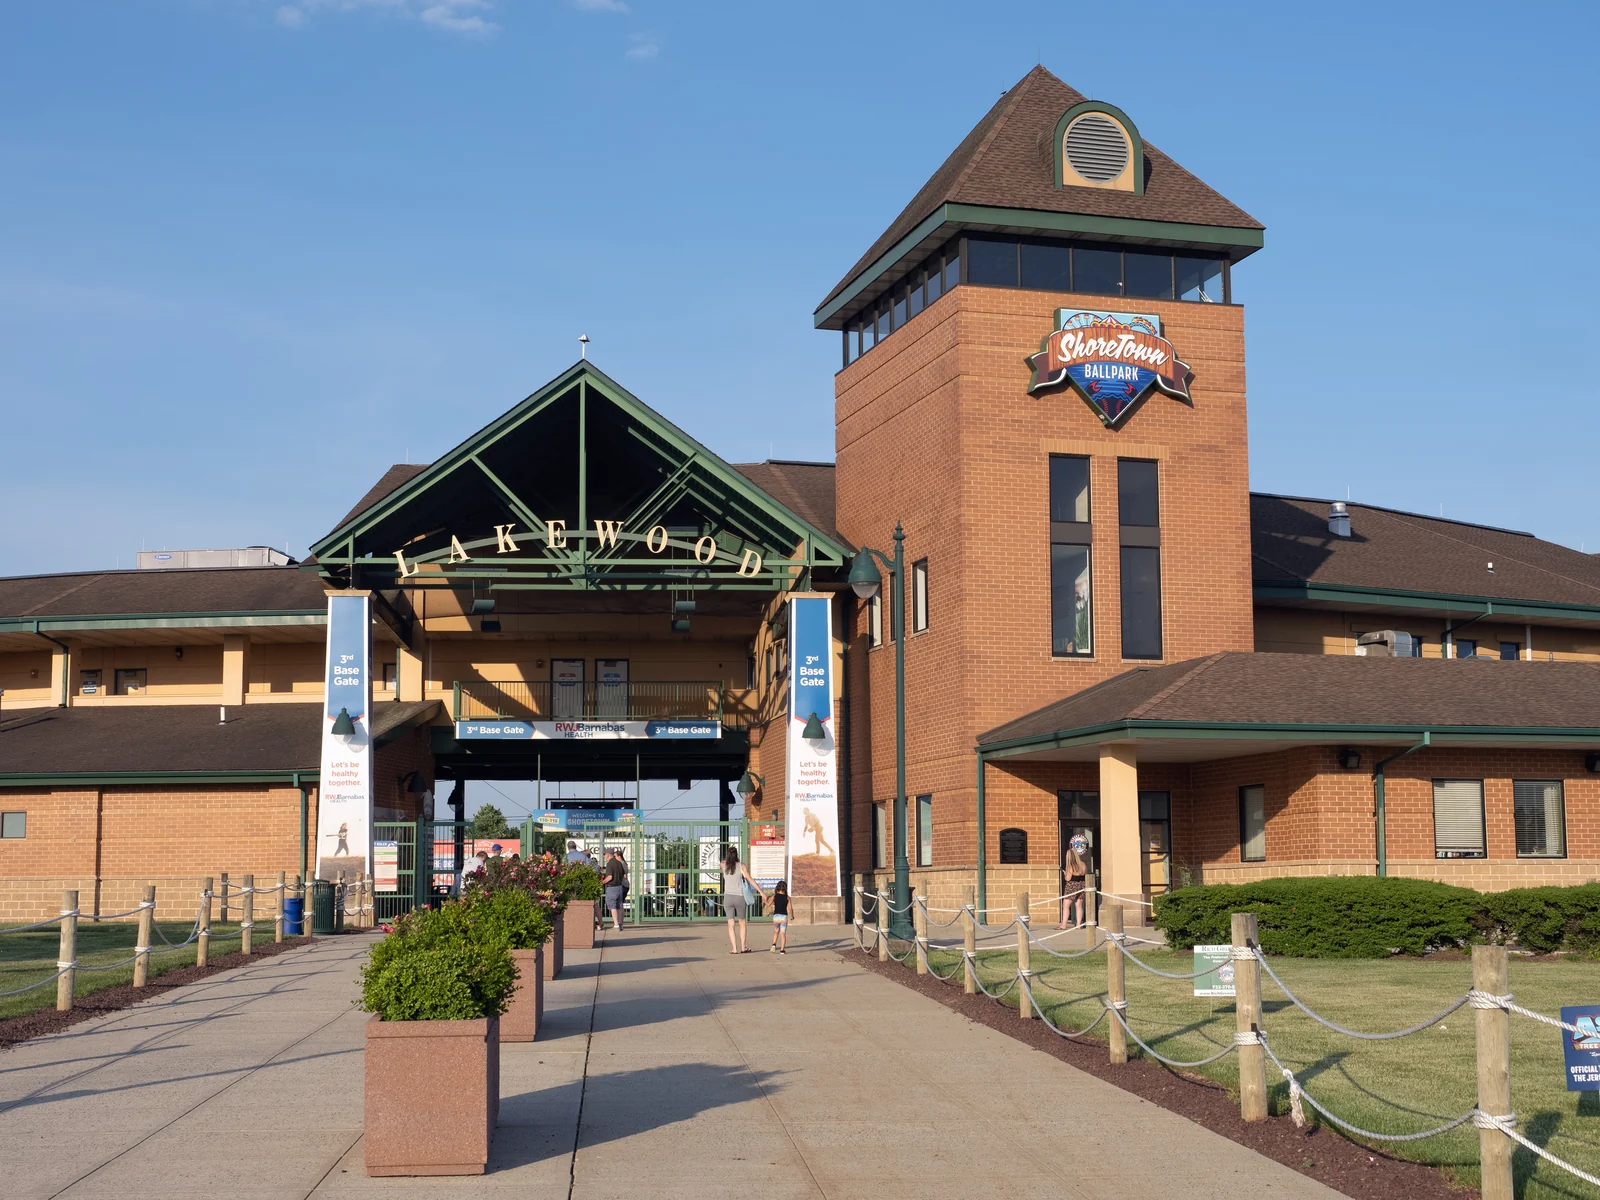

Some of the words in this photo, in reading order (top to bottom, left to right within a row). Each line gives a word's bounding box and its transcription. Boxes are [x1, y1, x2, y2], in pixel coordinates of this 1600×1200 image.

[1058, 331, 1169, 366] ShoreTown
[1085, 364, 1139, 381] BALLPARK
[392, 519, 763, 580] LAKEWOOD
[340, 654, 354, 664] 3rd
[805, 655, 819, 665] 3rd
[333, 665, 360, 675] Base
[799, 666, 825, 676] Base
[333, 676, 360, 686] Gate
[799, 677, 825, 687] Gate
[479, 726, 501, 734] Base
[503, 726, 525, 734] Gate
[555, 721, 625, 732] RWJBarnabas
[667, 726, 689, 734] Base
[690, 726, 712, 734] Gate
[331, 770, 359, 778] healthy
[800, 769, 827, 777] healthy
[1570, 1065, 1599, 1074] OFFICIAL
[1573, 1074, 1587, 1082] THE
